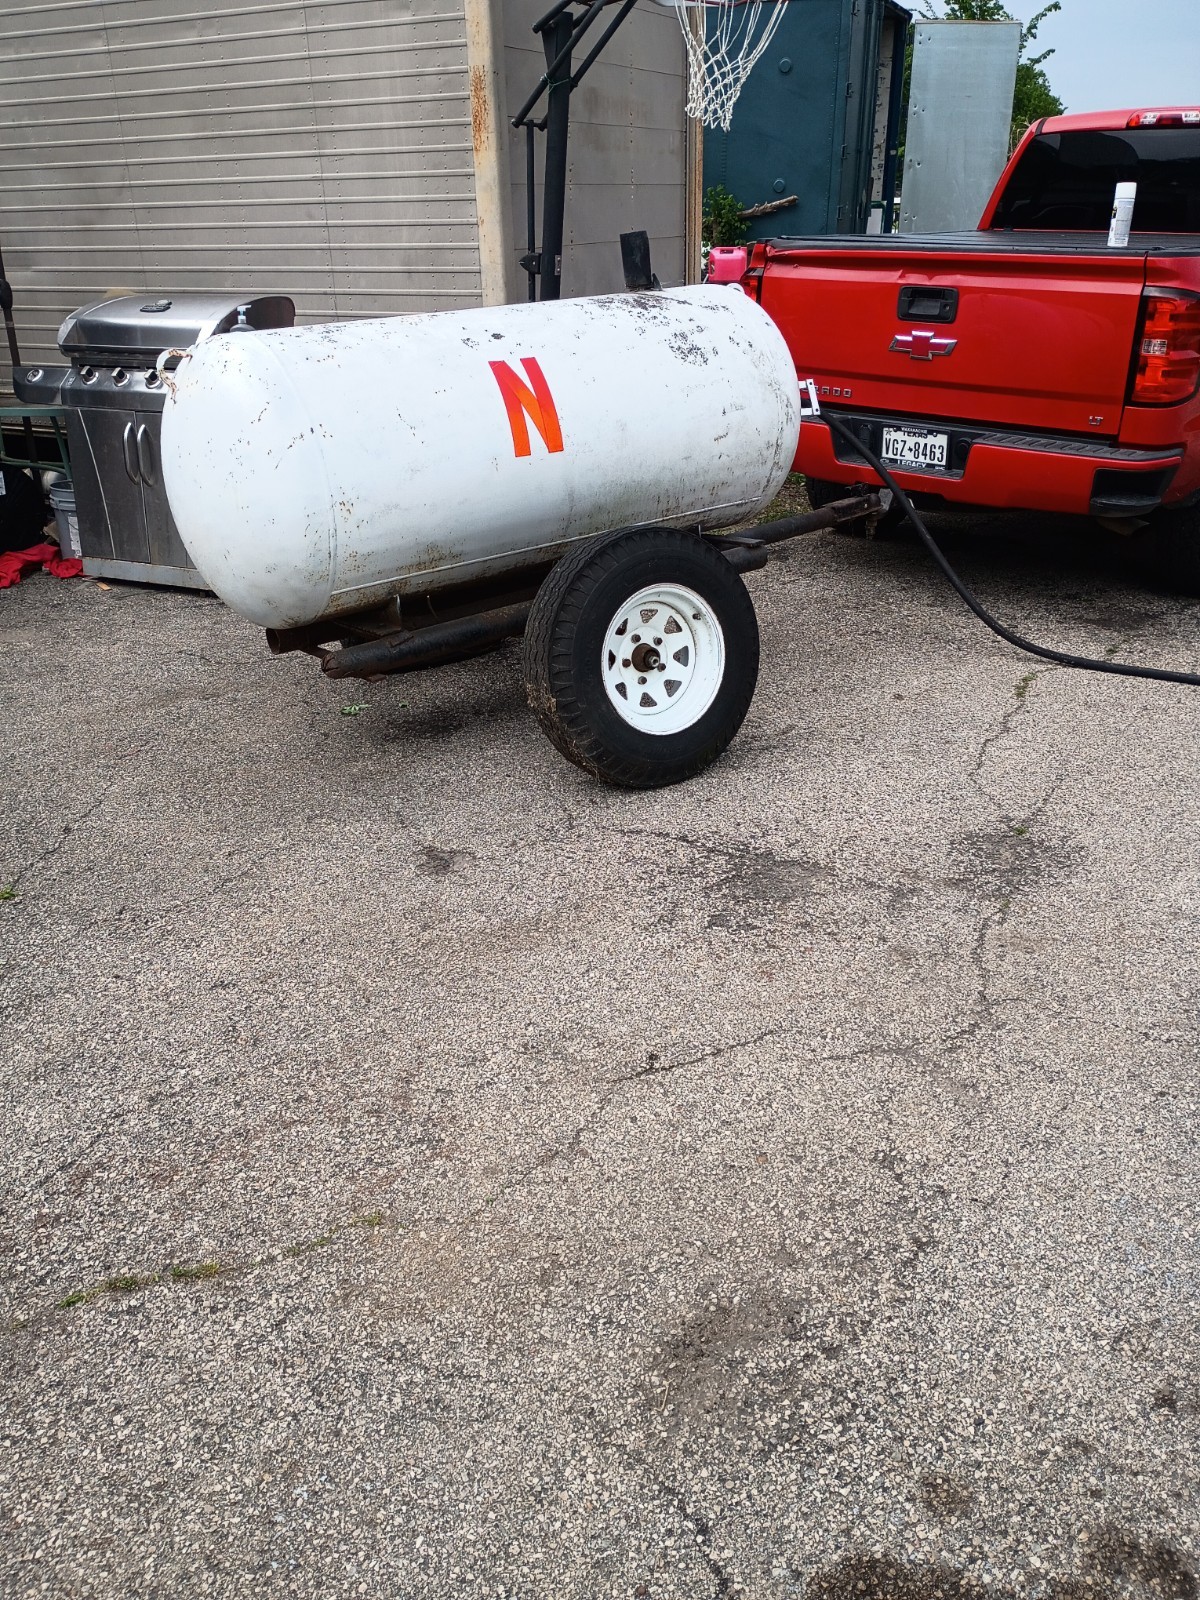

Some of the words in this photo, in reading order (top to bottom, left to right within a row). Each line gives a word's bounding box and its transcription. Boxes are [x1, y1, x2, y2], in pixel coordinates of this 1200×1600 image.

[802, 385, 852, 398] RADO
[488, 357, 564, 457] N
[1089, 416, 1104, 425] LT
[898, 460, 927, 468] LEGACY
